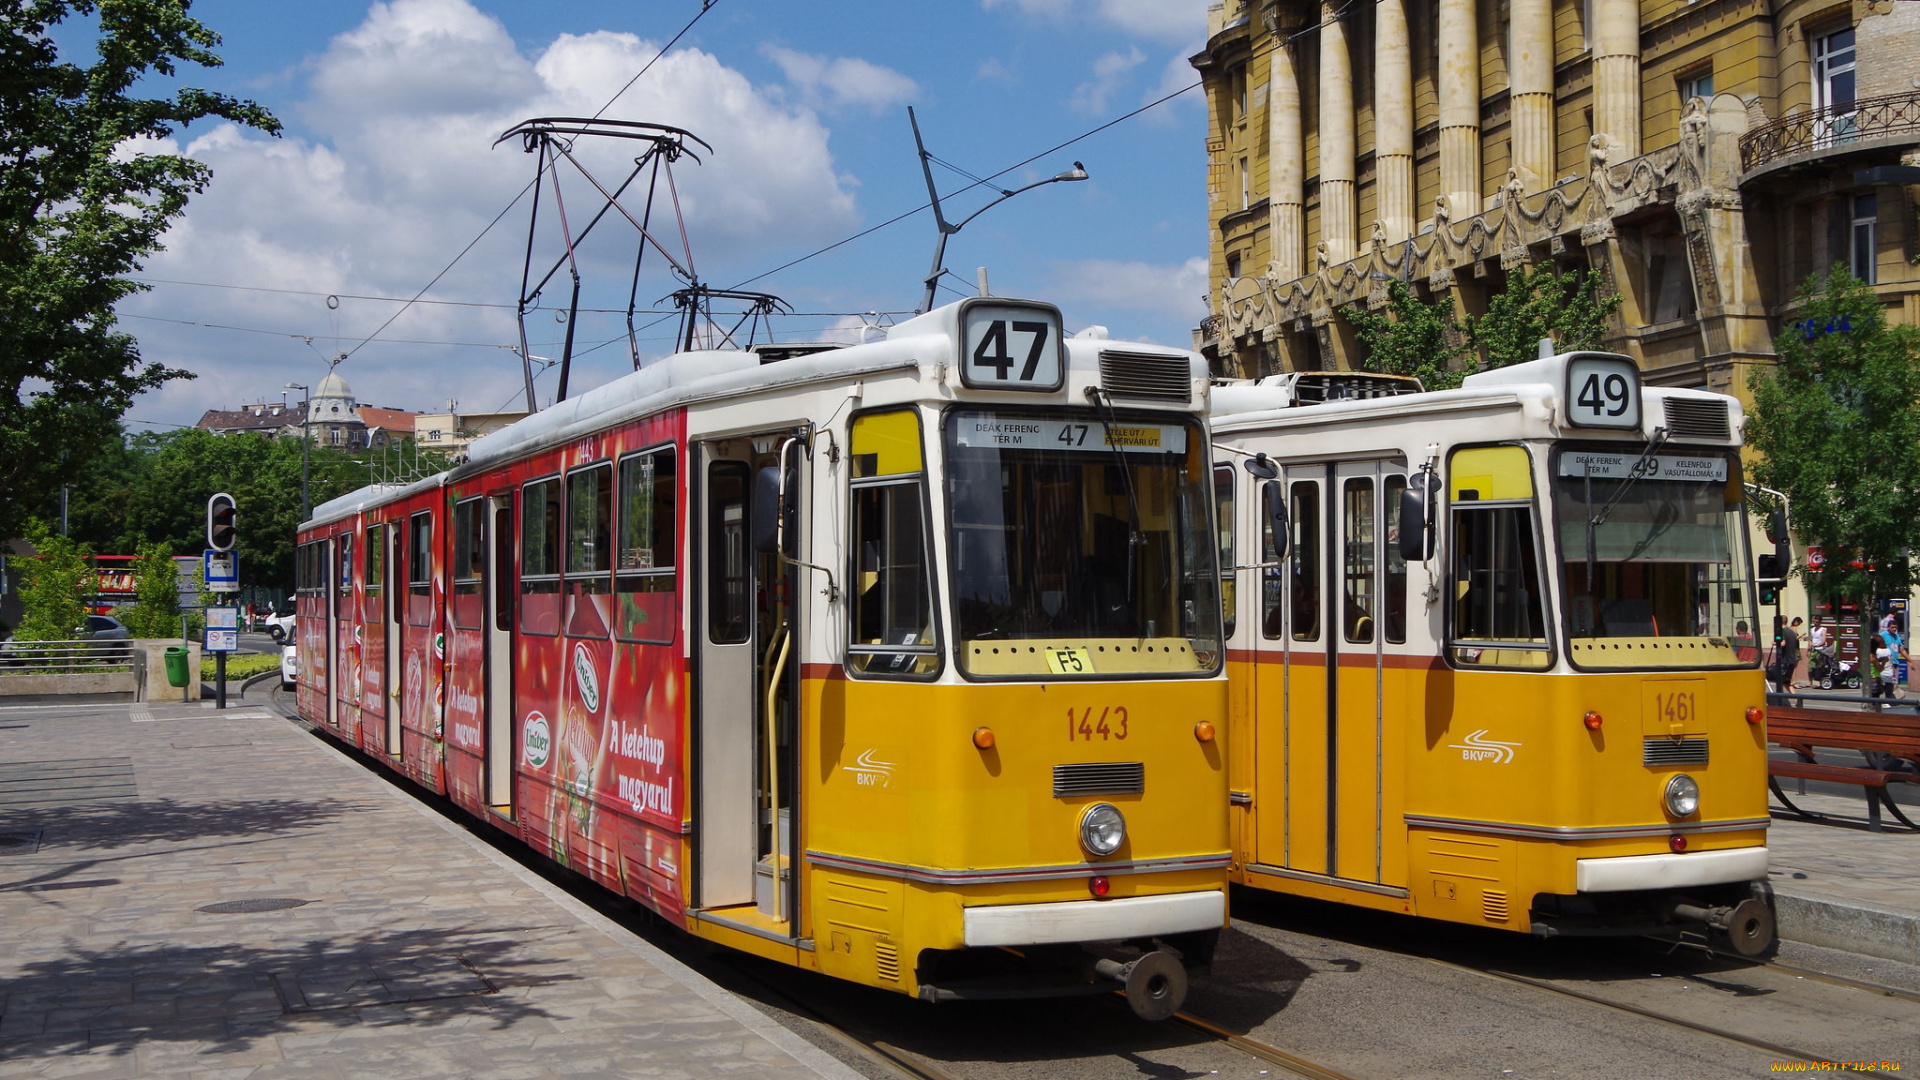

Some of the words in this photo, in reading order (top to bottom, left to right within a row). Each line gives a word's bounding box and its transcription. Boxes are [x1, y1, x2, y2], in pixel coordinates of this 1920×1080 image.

[973, 320, 1048, 381] 47
[1577, 373, 1630, 417] 49
[976, 422, 1001, 432] DEÁK
[1004, 424, 1040, 433] FERENC
[1058, 424, 1089, 446] 47
[993, 433, 1010, 443] TÉR
[1013, 435, 1022, 444] M
[1596, 456, 1623, 465] FERENC
[1602, 466, 1610, 474] M
[1634, 457, 1659, 476] 49
[1056, 651, 1083, 672] F5
[1656, 692, 1695, 722] 1461
[1067, 706, 1128, 742] 1443
[526, 728, 549, 751] Univer
[609, 719, 618, 754] A
[622, 720, 665, 774] ketchup
[1462, 749, 1484, 761] BKV
[856, 773, 876, 786] BKV
[618, 773, 673, 815] magyarul
